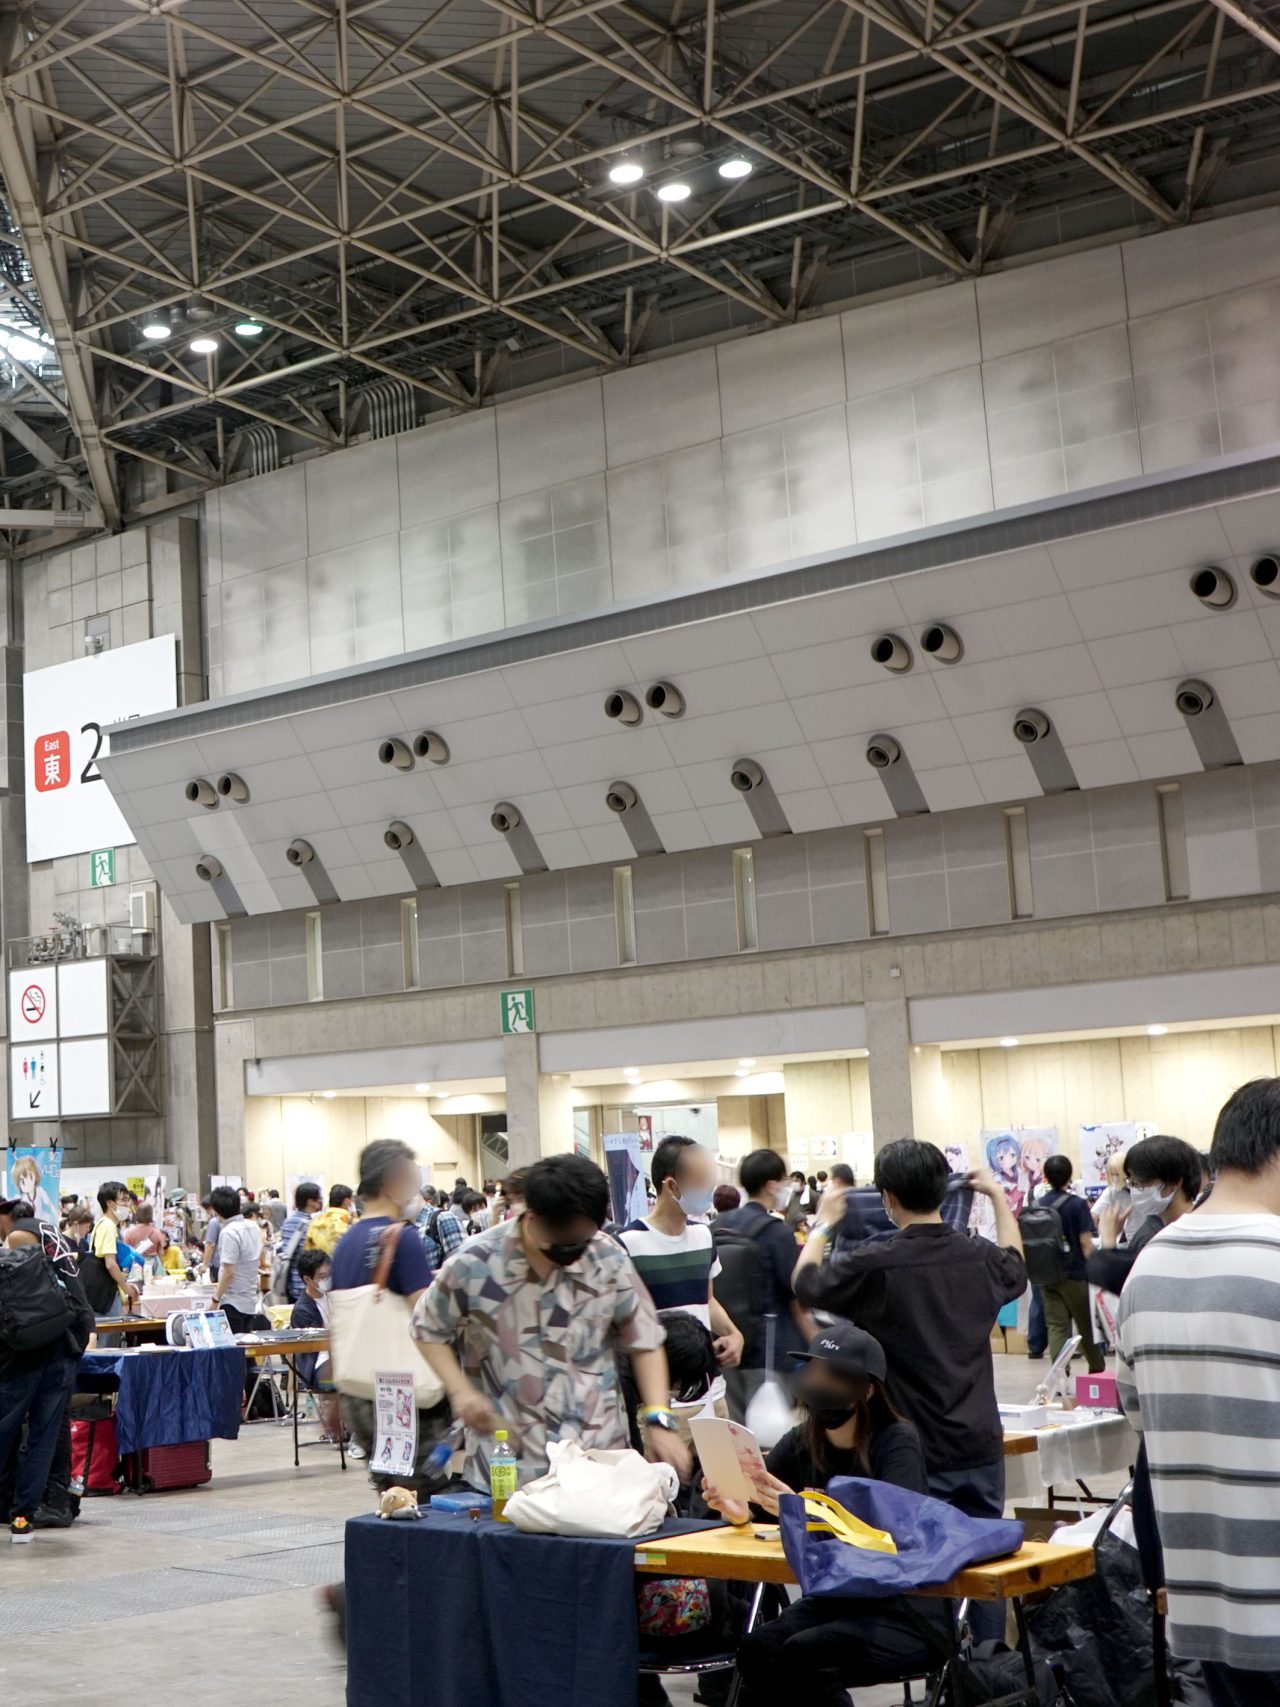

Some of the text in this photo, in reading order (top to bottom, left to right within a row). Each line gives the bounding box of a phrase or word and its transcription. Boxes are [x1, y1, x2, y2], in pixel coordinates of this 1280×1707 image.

[43, 722, 103, 786] 東 2
[44, 740, 60, 752] East
